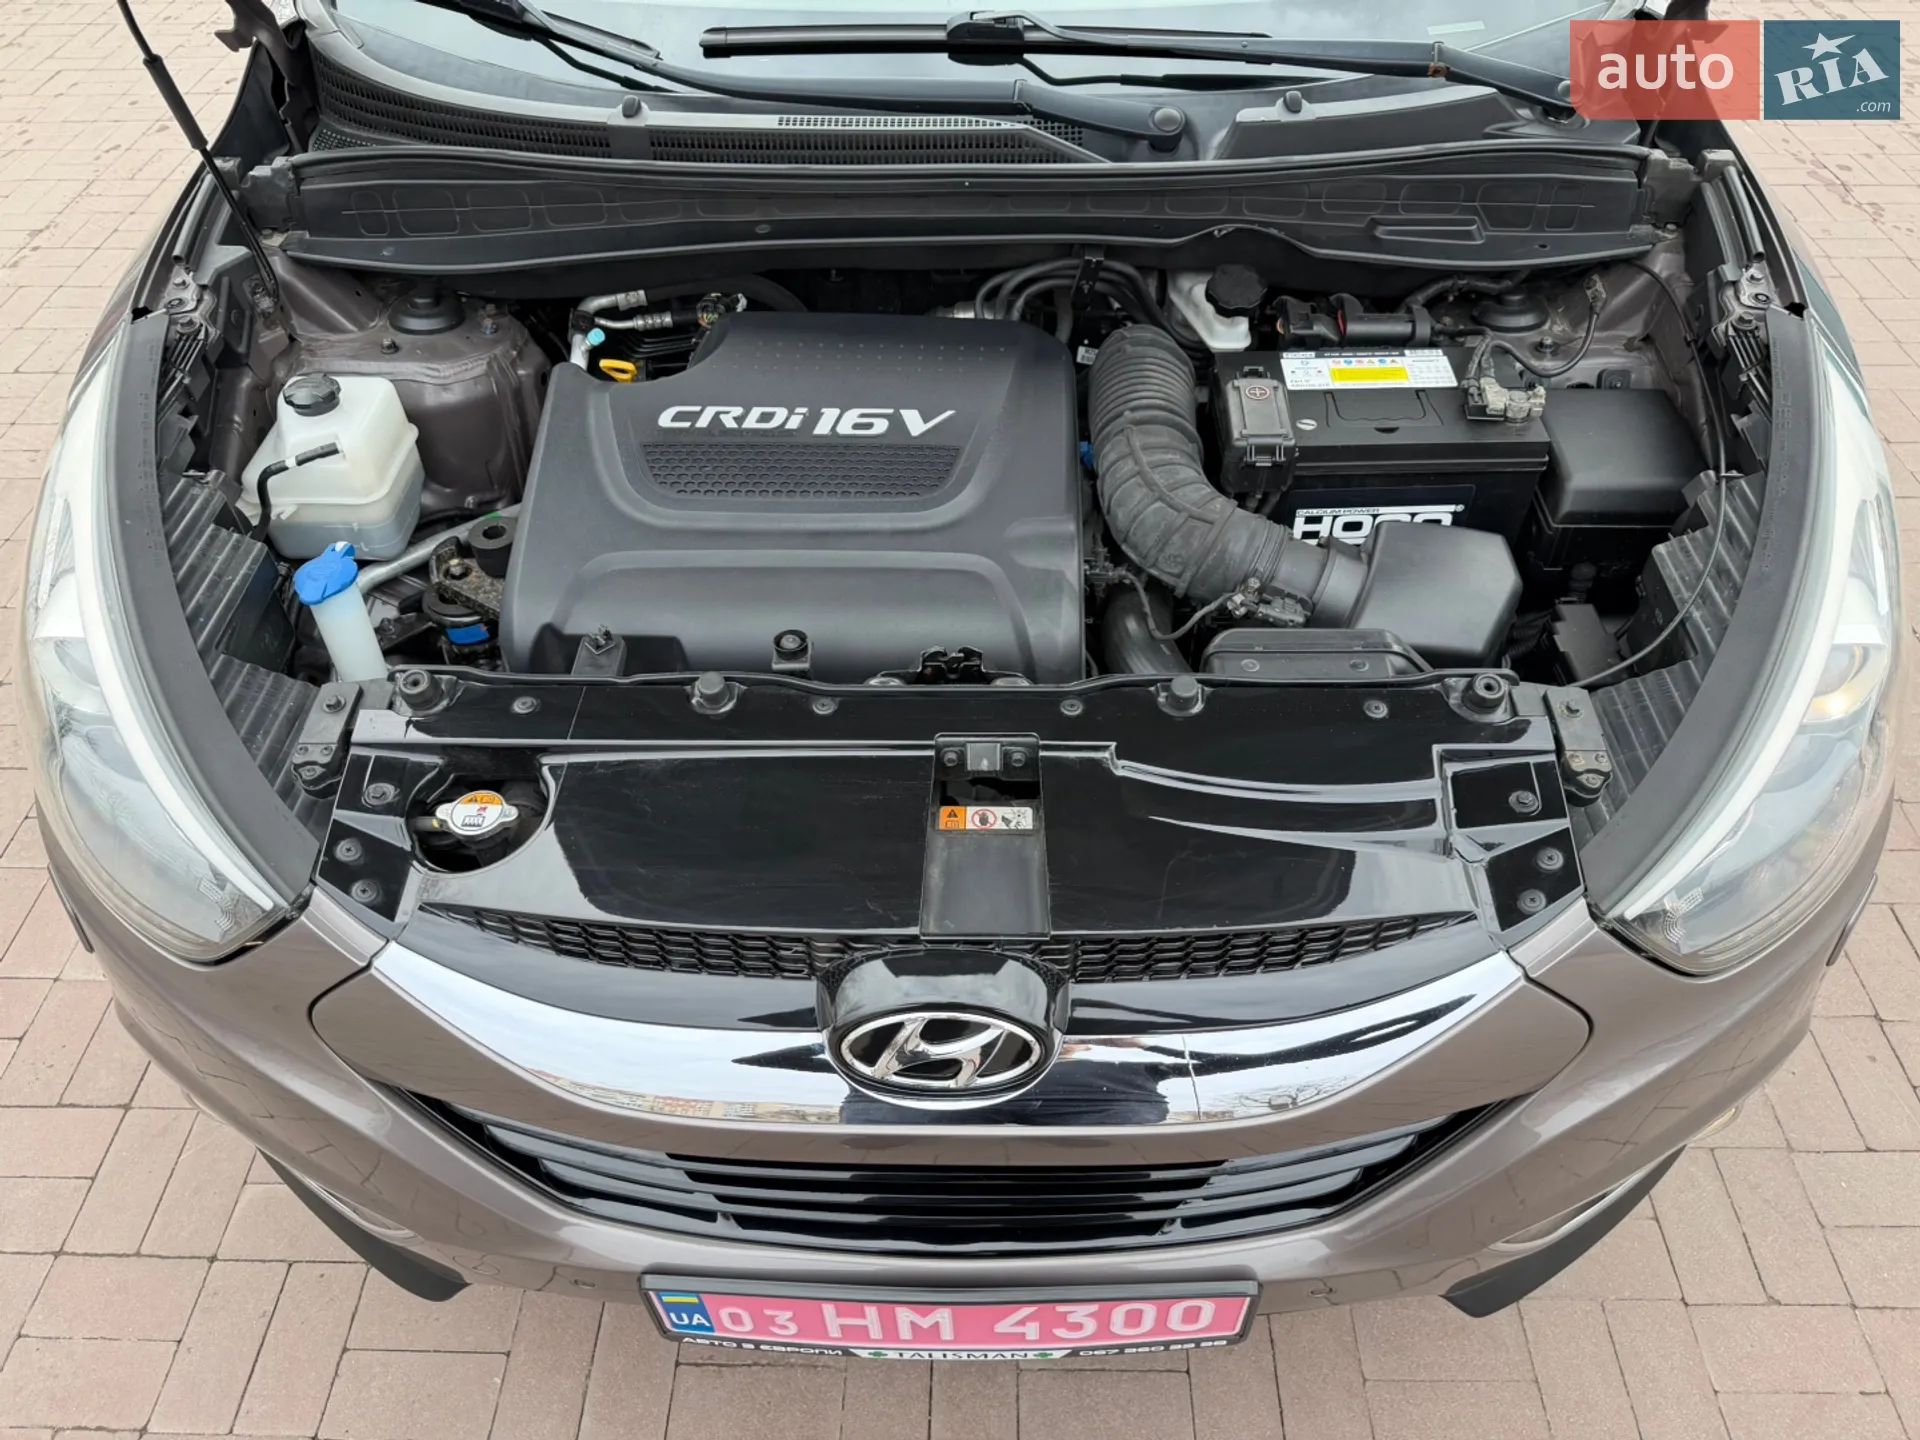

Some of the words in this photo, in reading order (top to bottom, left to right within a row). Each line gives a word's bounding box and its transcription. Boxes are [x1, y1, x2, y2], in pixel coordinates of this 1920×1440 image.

[658, 406, 808, 429] CRDi
[812, 408, 956, 437] 16V
[1343, 507, 1380, 515] POWER
[669, 1310, 711, 1330] UA
[718, 1307, 798, 1336] 03
[821, 1303, 955, 1341] HM
[994, 1300, 1215, 1340] 4300
[682, 1337, 737, 1348] АВТО
[896, 1351, 1028, 1360] TALISMAN
